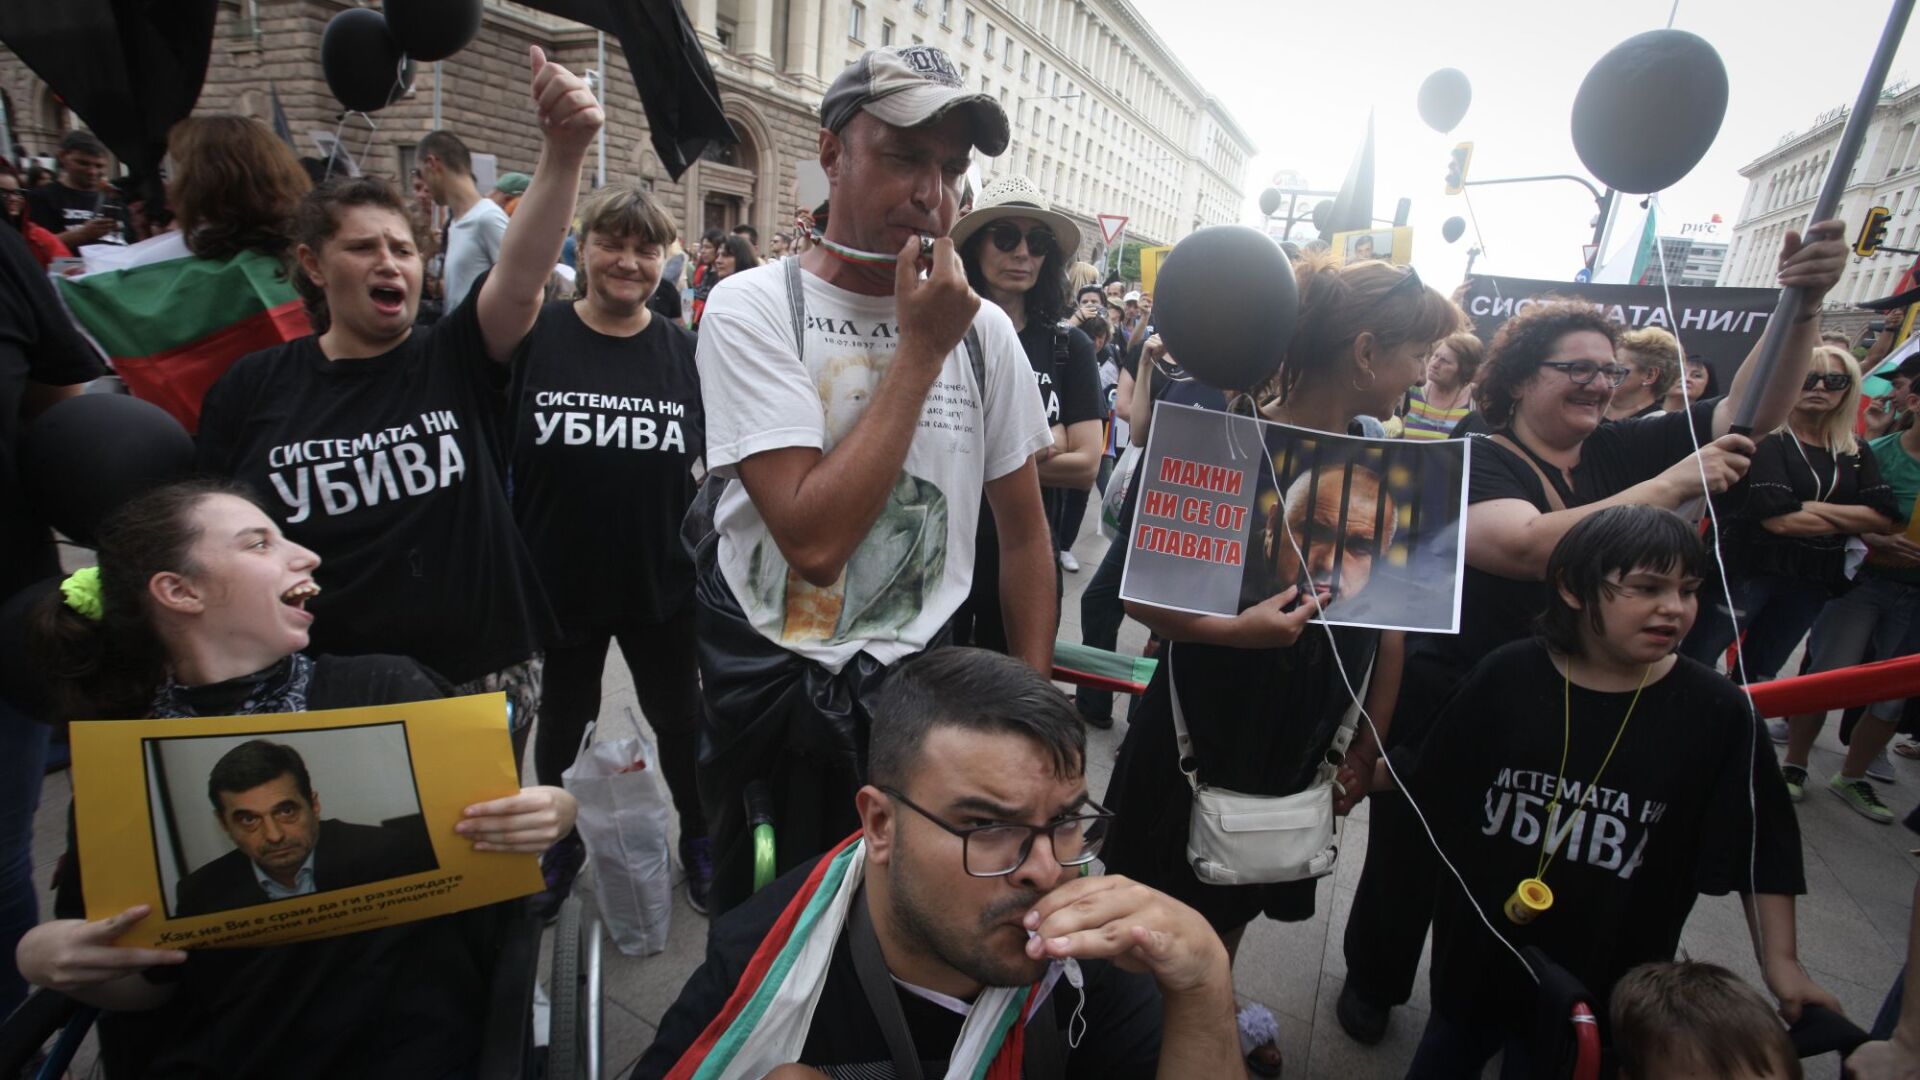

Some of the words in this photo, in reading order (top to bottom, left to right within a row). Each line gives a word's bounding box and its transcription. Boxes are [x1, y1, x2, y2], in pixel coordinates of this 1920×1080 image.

[1681, 308, 1774, 332] НИ/Г
[535, 391, 654, 413] СИСТЕМАТА
[658, 400, 685, 418] НИ
[269, 423, 418, 468] СИСТЕМАТА
[420, 410, 459, 434] НИ
[534, 411, 686, 454] УБИВА
[268, 434, 466, 524] УБИВА
[1159, 457, 1244, 496] МАХНИ
[1143, 489, 1179, 520] НИ
[1181, 497, 1213, 525] СЕ
[1214, 502, 1248, 532] ОТ
[1135, 523, 1243, 566] ГЛАВАТА
[1494, 767, 1630, 818] ИСТЕМАТА
[254, 917, 265, 925] е
[268, 906, 314, 923] срам
[317, 902, 339, 913] да
[341, 896, 361, 907] ги
[364, 874, 464, 903] разхождате
[307, 910, 349, 925] деца
[352, 904, 374, 915] по
